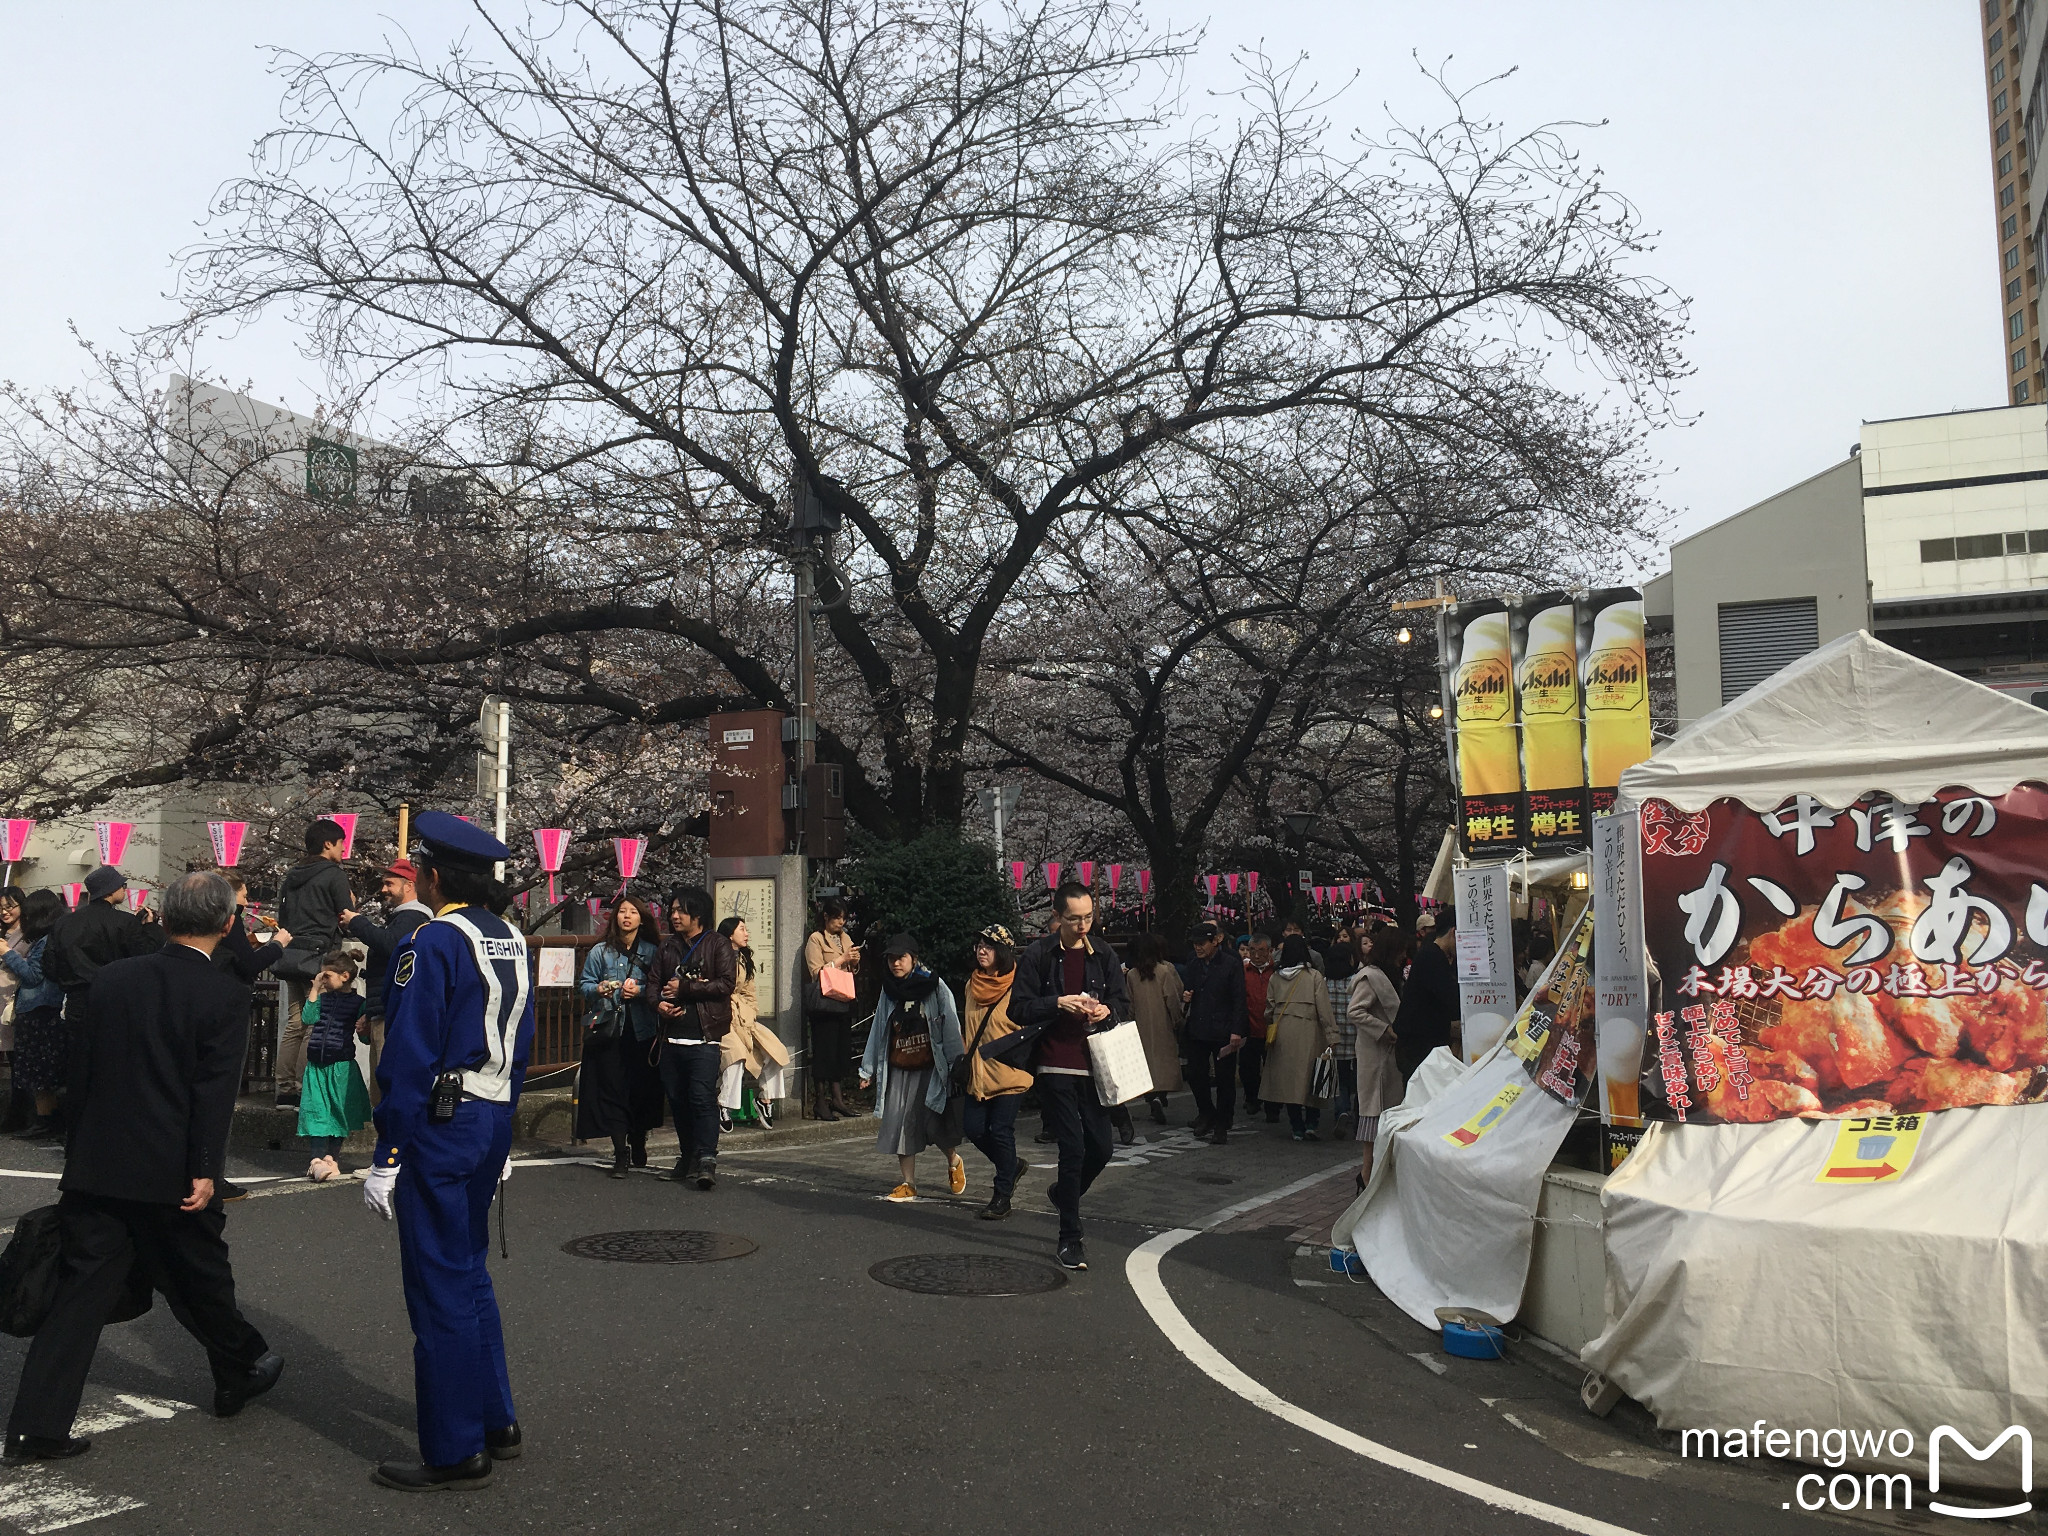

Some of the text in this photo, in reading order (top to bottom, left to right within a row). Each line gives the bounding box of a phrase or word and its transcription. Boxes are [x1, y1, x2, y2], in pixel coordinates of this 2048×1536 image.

[1457, 674, 1504, 698] Asahi
[1521, 667, 1571, 691] Asahi
[1586, 663, 1638, 686] Asahi
[1474, 695, 1483, 704] 生
[1539, 689, 1549, 698] 生
[1604, 684, 1614, 693] 生
[1465, 800, 1485, 808] アサヒ
[1529, 795, 1550, 803] アサヒ
[1529, 799, 1580, 812] スーパードライ
[1592, 792, 1613, 800] アサヒ
[1465, 804, 1515, 816] スーパードライ
[1466, 815, 1518, 842] 樽生
[1530, 810, 1583, 837] 樽生
[1760, 793, 1997, 855] 中津の
[1646, 823, 1709, 856] 大分
[1604, 828, 1613, 898] この辛口。
[1467, 876, 1480, 927] この辛口。
[1616, 823, 1628, 963] 世界でただひとつ、
[480, 940, 524, 957] TEISHIN
[1681, 1004, 1721, 1092] 極上からあげ
